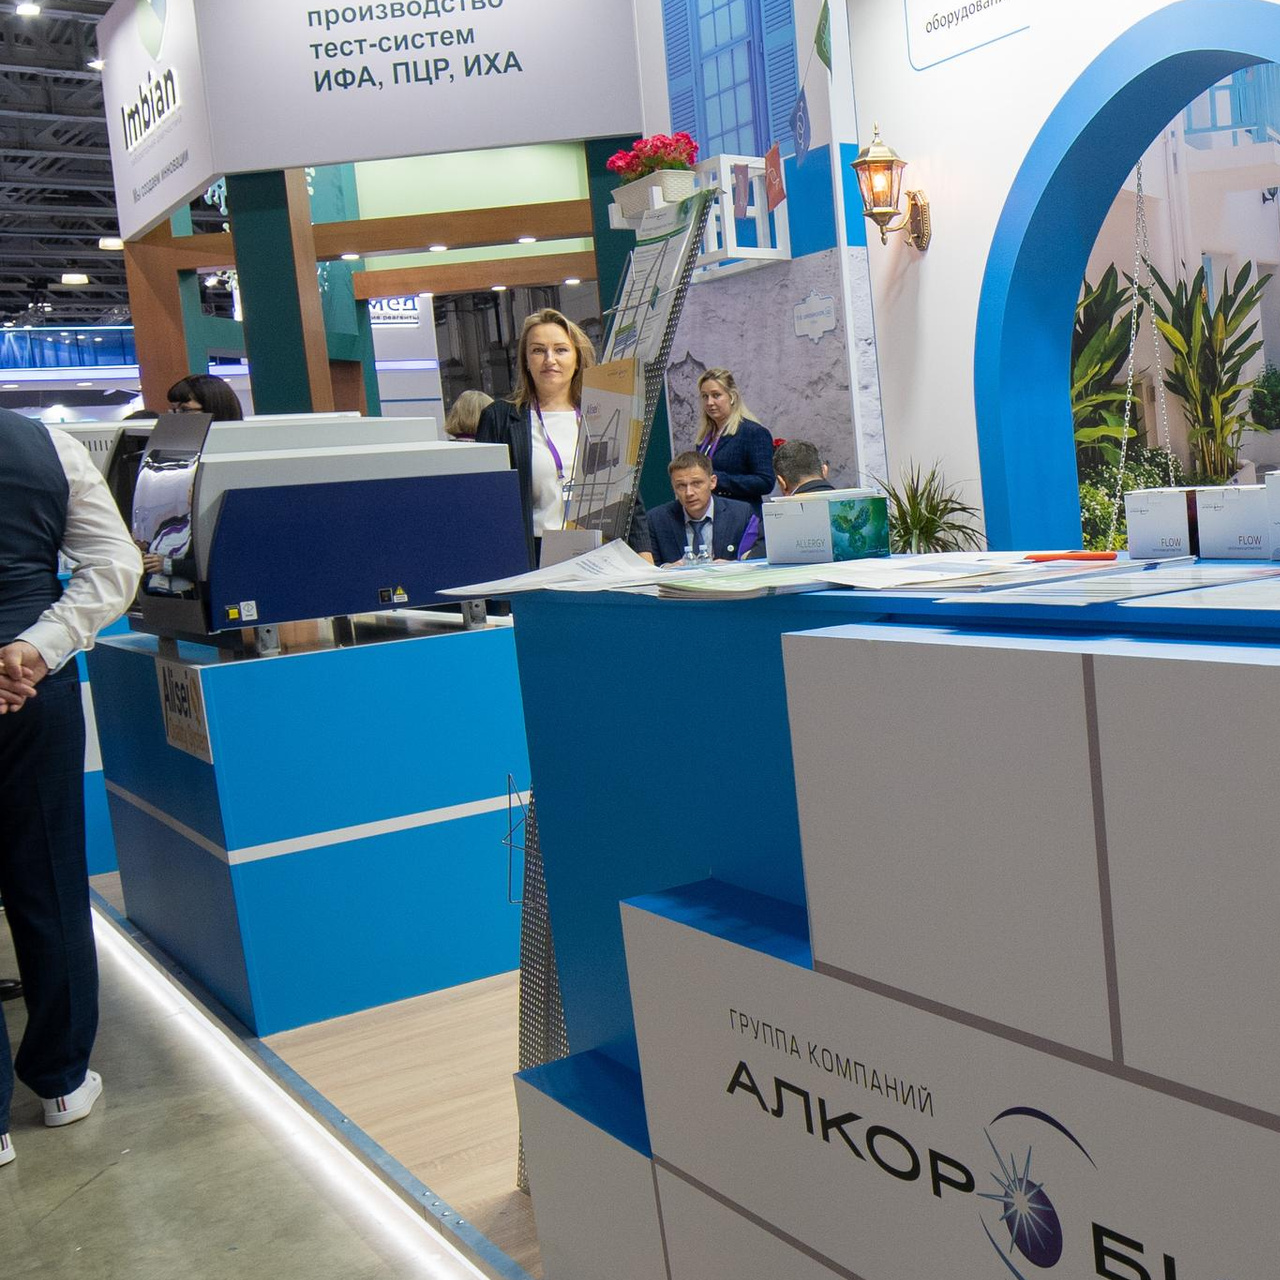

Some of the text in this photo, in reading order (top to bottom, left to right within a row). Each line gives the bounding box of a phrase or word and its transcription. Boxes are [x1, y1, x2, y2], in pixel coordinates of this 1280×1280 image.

[309, 27, 475, 59] тест-систем
[314, 51, 523, 92] ИФА, ПЦР, ИХА
[121, 68, 176, 150] Imbian
[795, 538, 826, 549] ALLERGY
[1160, 537, 1182, 548] FLOW
[1238, 535, 1262, 546] FLOW
[729, 1008, 934, 1117] ГРУППА КОМПАНИЙ
[726, 1060, 975, 1198] АЛКОР
